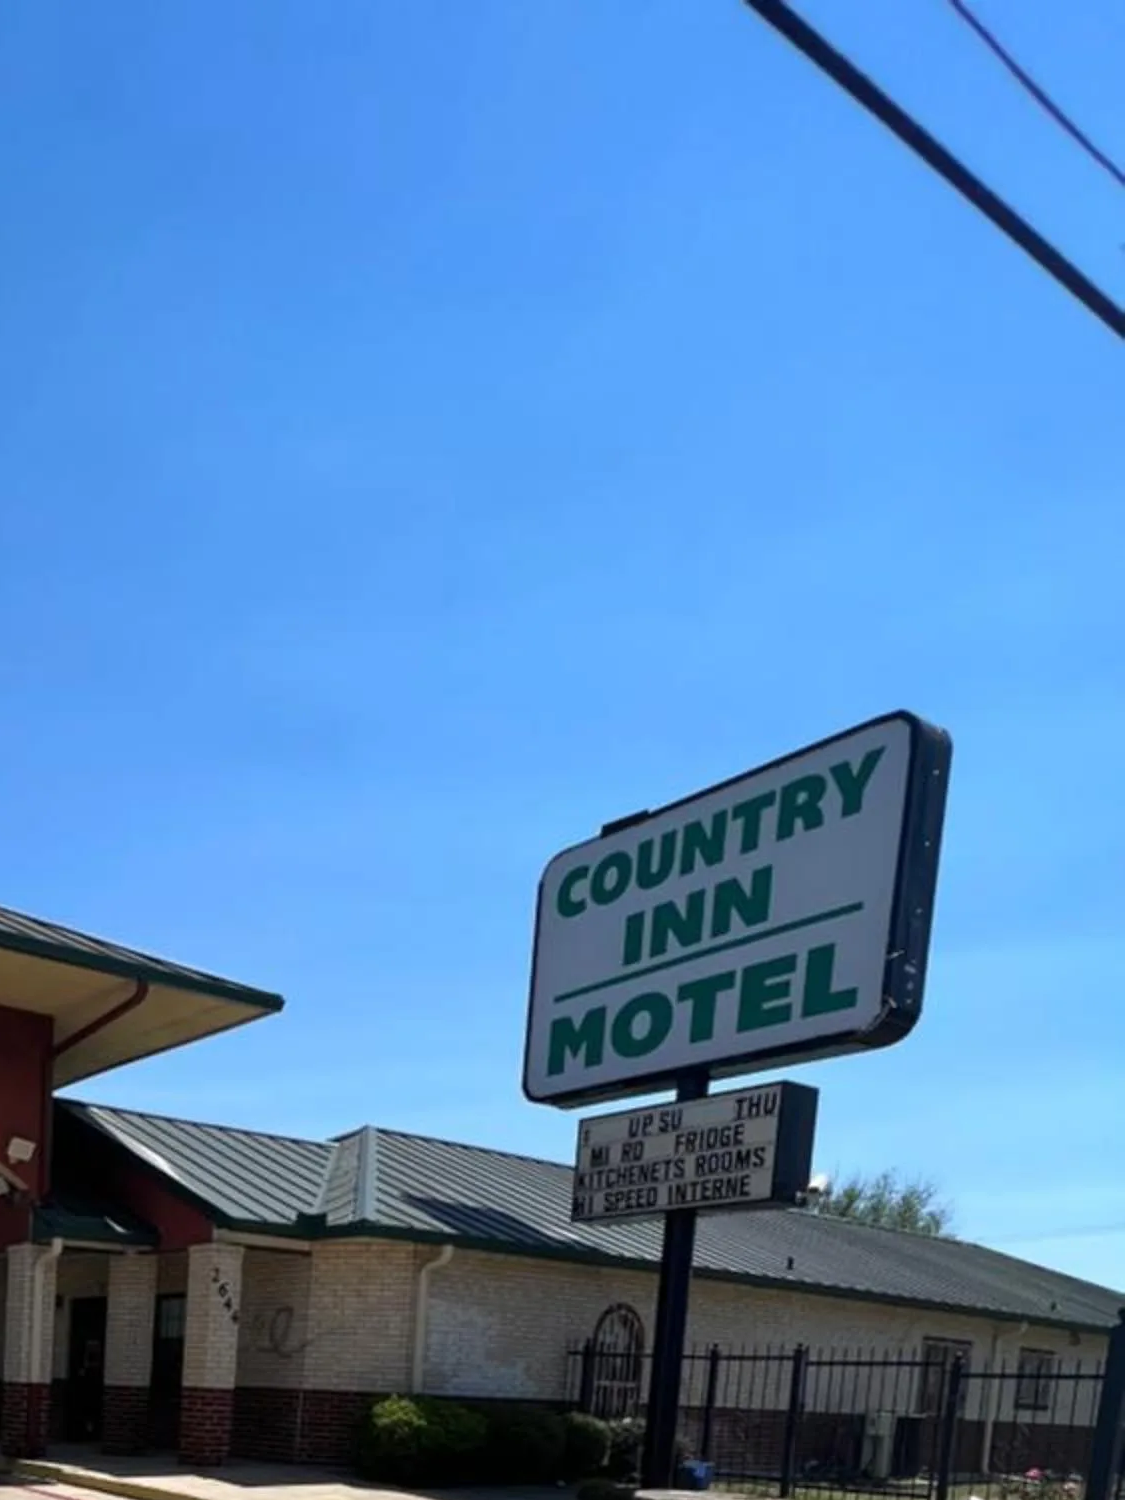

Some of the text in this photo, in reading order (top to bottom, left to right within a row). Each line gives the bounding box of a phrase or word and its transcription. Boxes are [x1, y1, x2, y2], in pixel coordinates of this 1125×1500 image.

[556, 745, 885, 918] COUNTRY
[622, 864, 773, 965] INN
[546, 943, 859, 1076] MOTEL
[734, 1092, 778, 1121] THU
[675, 1123, 745, 1155] FRIDGE
[576, 1146, 766, 1188] KITCHENETS ROOMS
[573, 1174, 750, 1216] HI SPEED INTERNE
